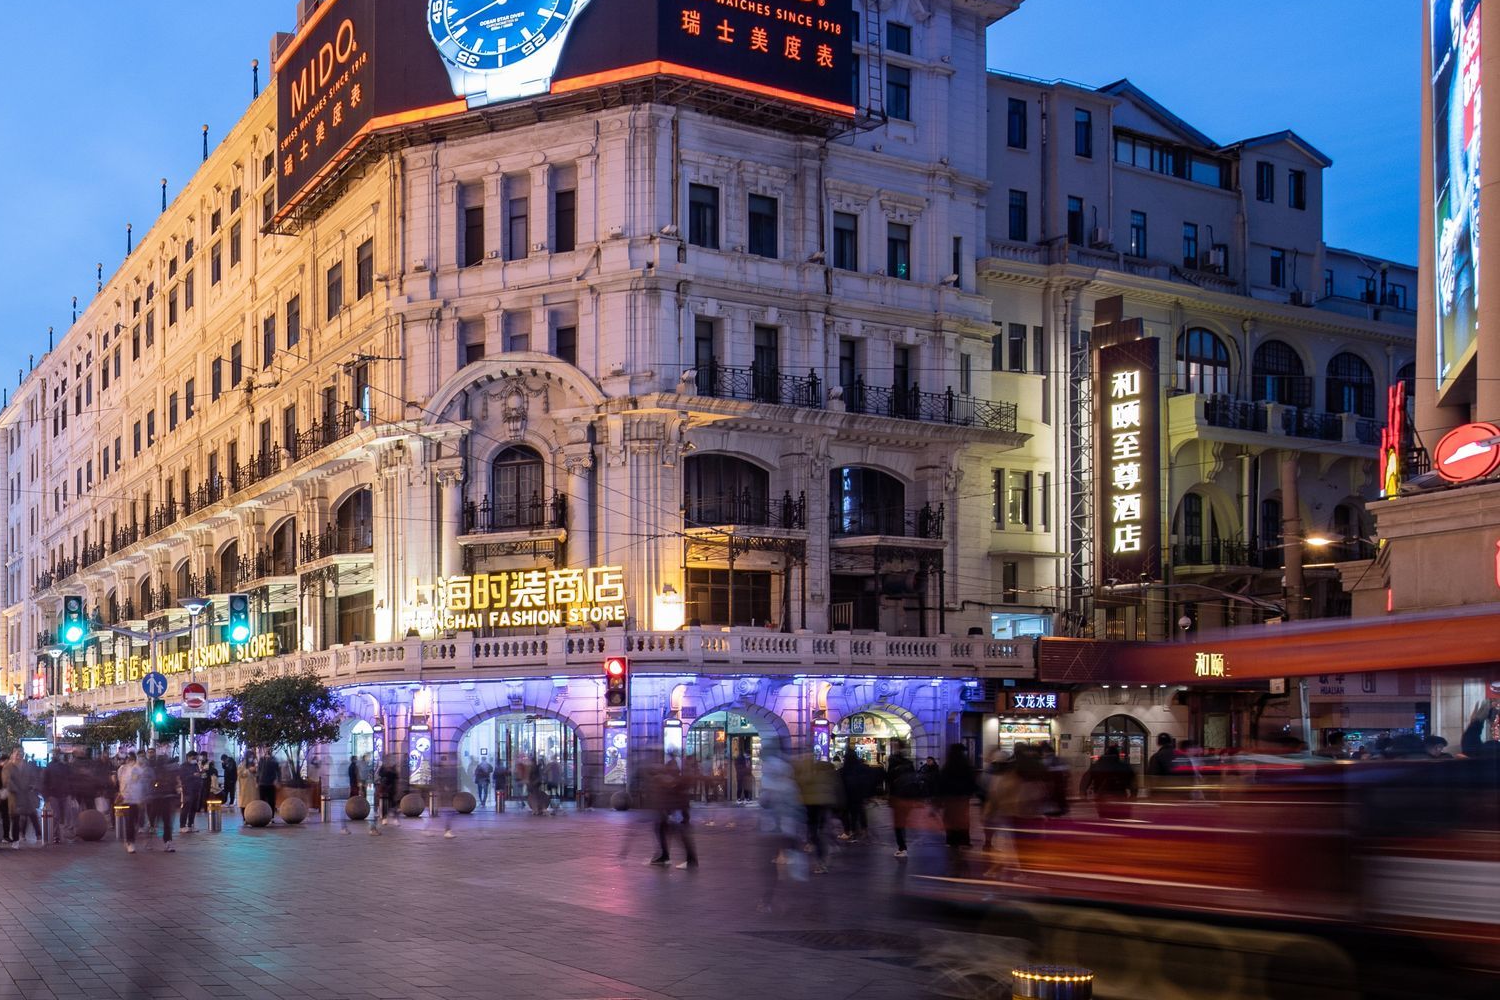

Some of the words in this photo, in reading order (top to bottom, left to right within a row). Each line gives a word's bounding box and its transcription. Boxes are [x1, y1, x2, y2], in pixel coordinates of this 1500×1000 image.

[681, 10, 834, 68] 瑞士美度表
[776, 8, 813, 27] SINCE
[818, 19, 842, 35] 1918
[291, 18, 354, 119] MIDO
[280, 129, 298, 152] SWISS
[299, 95, 327, 132] WATCHES
[329, 70, 349, 99] SINCE
[351, 51, 367, 75] 1918
[283, 83, 362, 177] 瑞士美度表
[1111, 369, 1143, 554] 和颐至尊酒店
[404, 565, 624, 611] 上海时装商店
[489, 609, 561, 627] FASHION
[568, 605, 626, 623] STORE
[141, 651, 186, 677] SHNGHAI
[188, 641, 230, 670] FASHION
[1195, 652, 1232, 678] 和颐
[1014, 693, 1057, 709] 文龙水果
